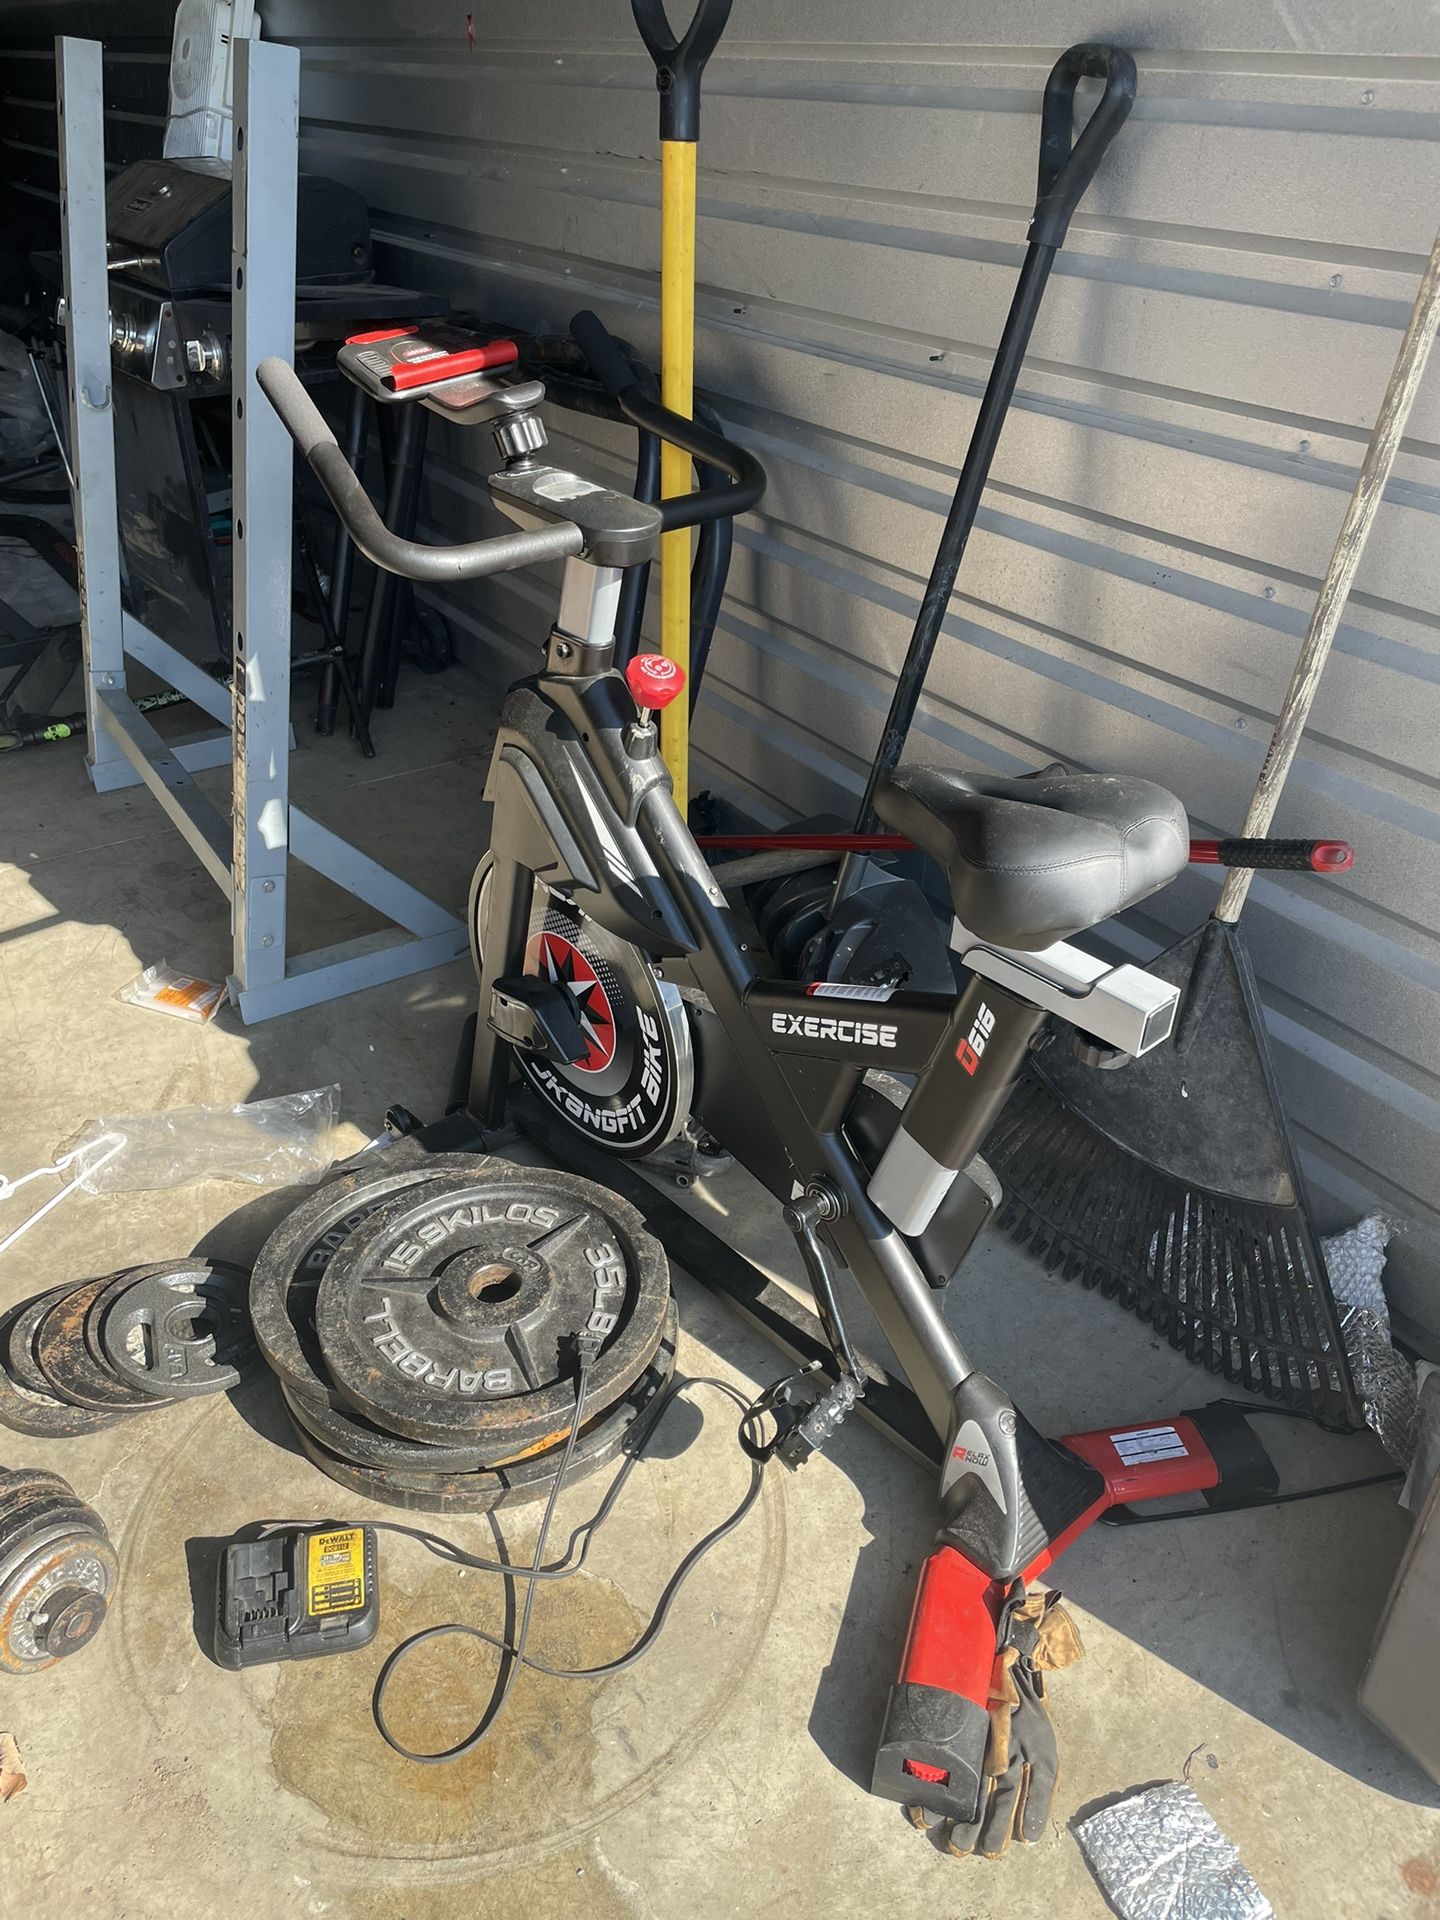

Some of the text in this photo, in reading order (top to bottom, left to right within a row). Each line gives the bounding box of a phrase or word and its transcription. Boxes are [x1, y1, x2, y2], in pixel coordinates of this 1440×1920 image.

[635, 1005, 663, 1107] BIKE
[771, 1011, 898, 1049] EXERCISE
[363, 1297, 512, 1395] BARBELL
[965, 1456, 989, 1467] NOW
